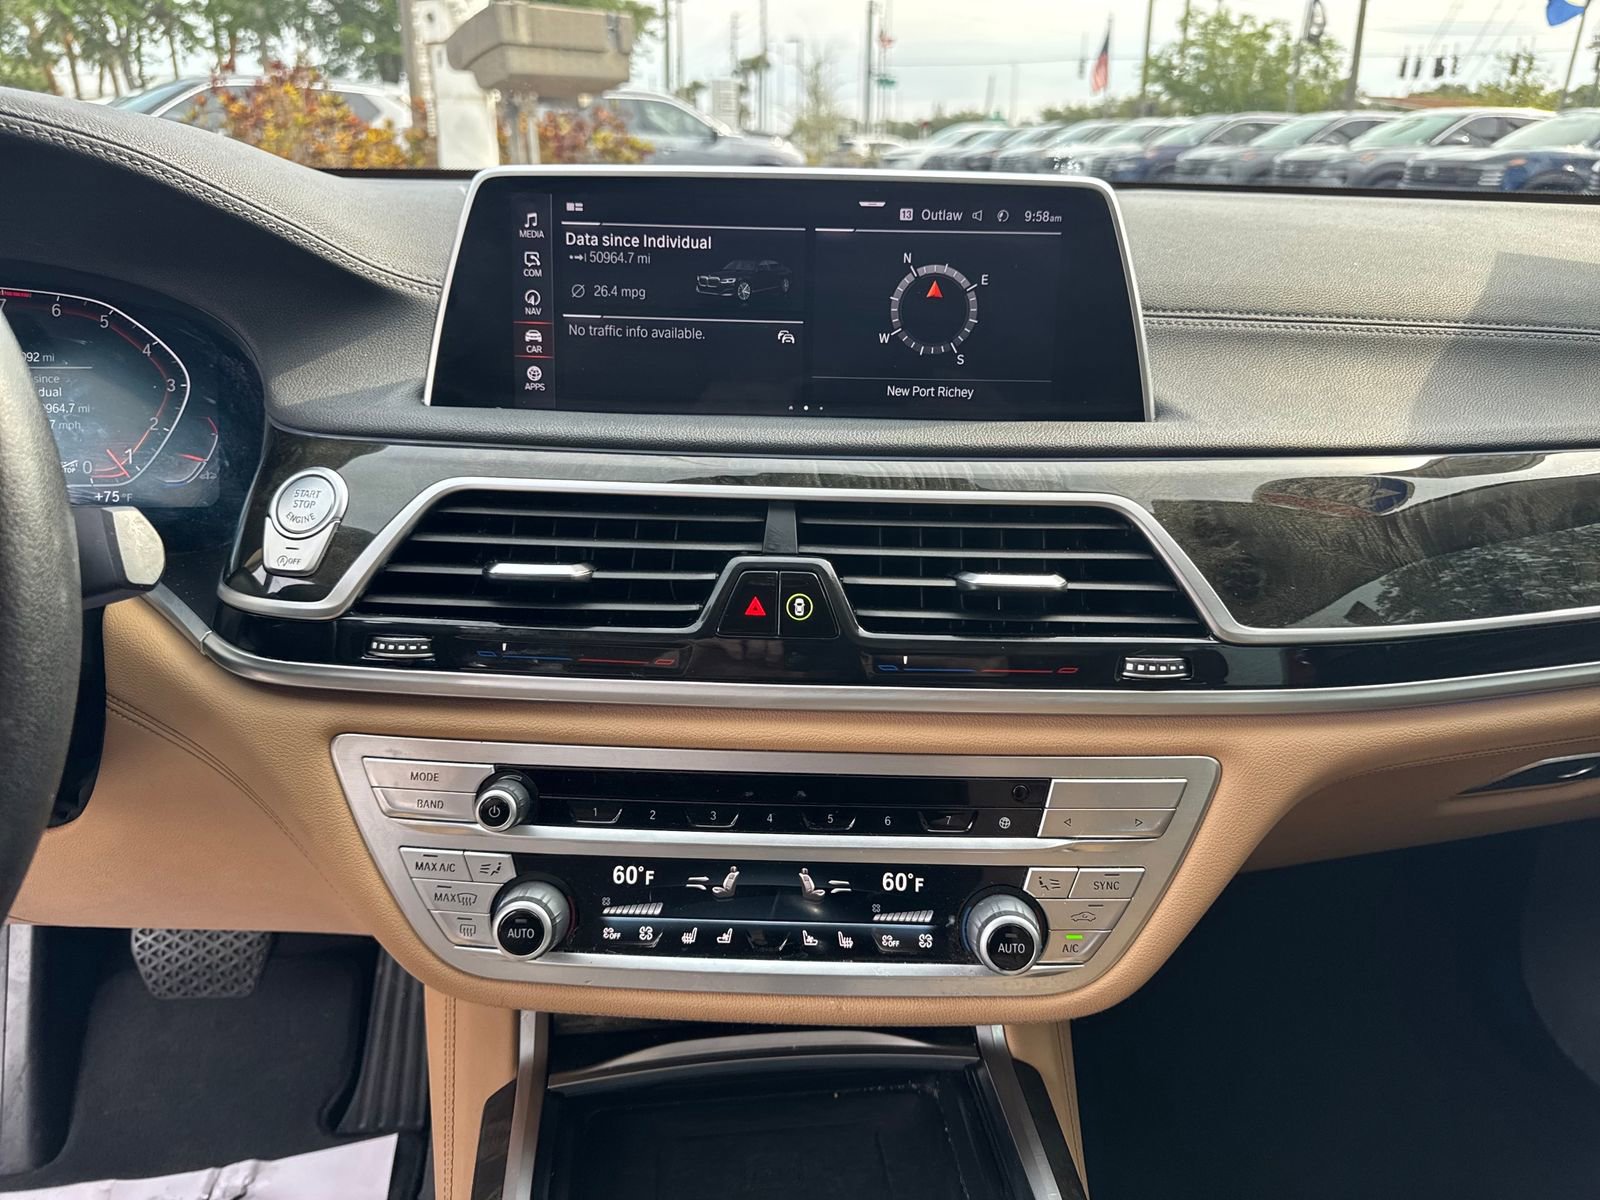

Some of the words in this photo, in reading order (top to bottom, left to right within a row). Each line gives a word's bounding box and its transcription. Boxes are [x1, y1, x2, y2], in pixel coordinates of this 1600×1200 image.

[922, 210, 962, 220] Outlaw
[1024, 211, 1062, 222] 9:58am
[519, 230, 544, 238] MEDIA
[566, 232, 598, 246] Data
[602, 233, 640, 248] since
[644, 234, 712, 249] Individual
[589, 251, 634, 264] 50964.7
[637, 253, 650, 264] mi
[904, 253, 912, 263] N
[523, 269, 542, 277] COM
[981, 275, 988, 285] E
[593, 285, 618, 297] 26.4
[621, 287, 646, 300] mpg
[52, 304, 61, 317] 6
[100, 315, 109, 328] 5
[568, 324, 585, 336] No
[589, 325, 622, 337] traffic
[625, 326, 648, 338] info
[651, 327, 705, 340] available.
[879, 333, 890, 343] W
[142, 344, 151, 357] 4
[42, 353, 55, 362] mi
[957, 355, 964, 365] S
[34, 375, 60, 383] since
[167, 379, 176, 392] 3
[887, 386, 910, 396] New
[912, 386, 935, 397] Port
[937, 387, 974, 400] Richey
[78, 404, 90, 413] mi
[150, 417, 159, 430] 2
[125, 449, 132, 464] 1
[83, 460, 92, 474] 0
[294, 489, 322, 499] START
[293, 500, 316, 509] STOP
[286, 511, 316, 524] ENGINE
[410, 771, 439, 782] MODE
[416, 799, 444, 809] BAND
[593, 808, 597, 816] 1
[650, 810, 656, 820] 2
[710, 811, 716, 821] 3
[766, 814, 773, 823] 4
[828, 814, 834, 823] 5
[884, 816, 891, 826] 6
[946, 816, 952, 825] 7
[415, 861, 437, 872] MAX
[437, 863, 456, 873] A/C
[613, 865, 655, 885] 60°F
[882, 872, 924, 892] 60°F
[1093, 881, 1120, 891] SYNC
[434, 892, 456, 902] MAX
[507, 928, 534, 939] AUTO
[609, 932, 621, 940] OFF
[888, 939, 899, 947] OFF
[998, 943, 1025, 953] AUTO
[1062, 944, 1079, 953] A/C
